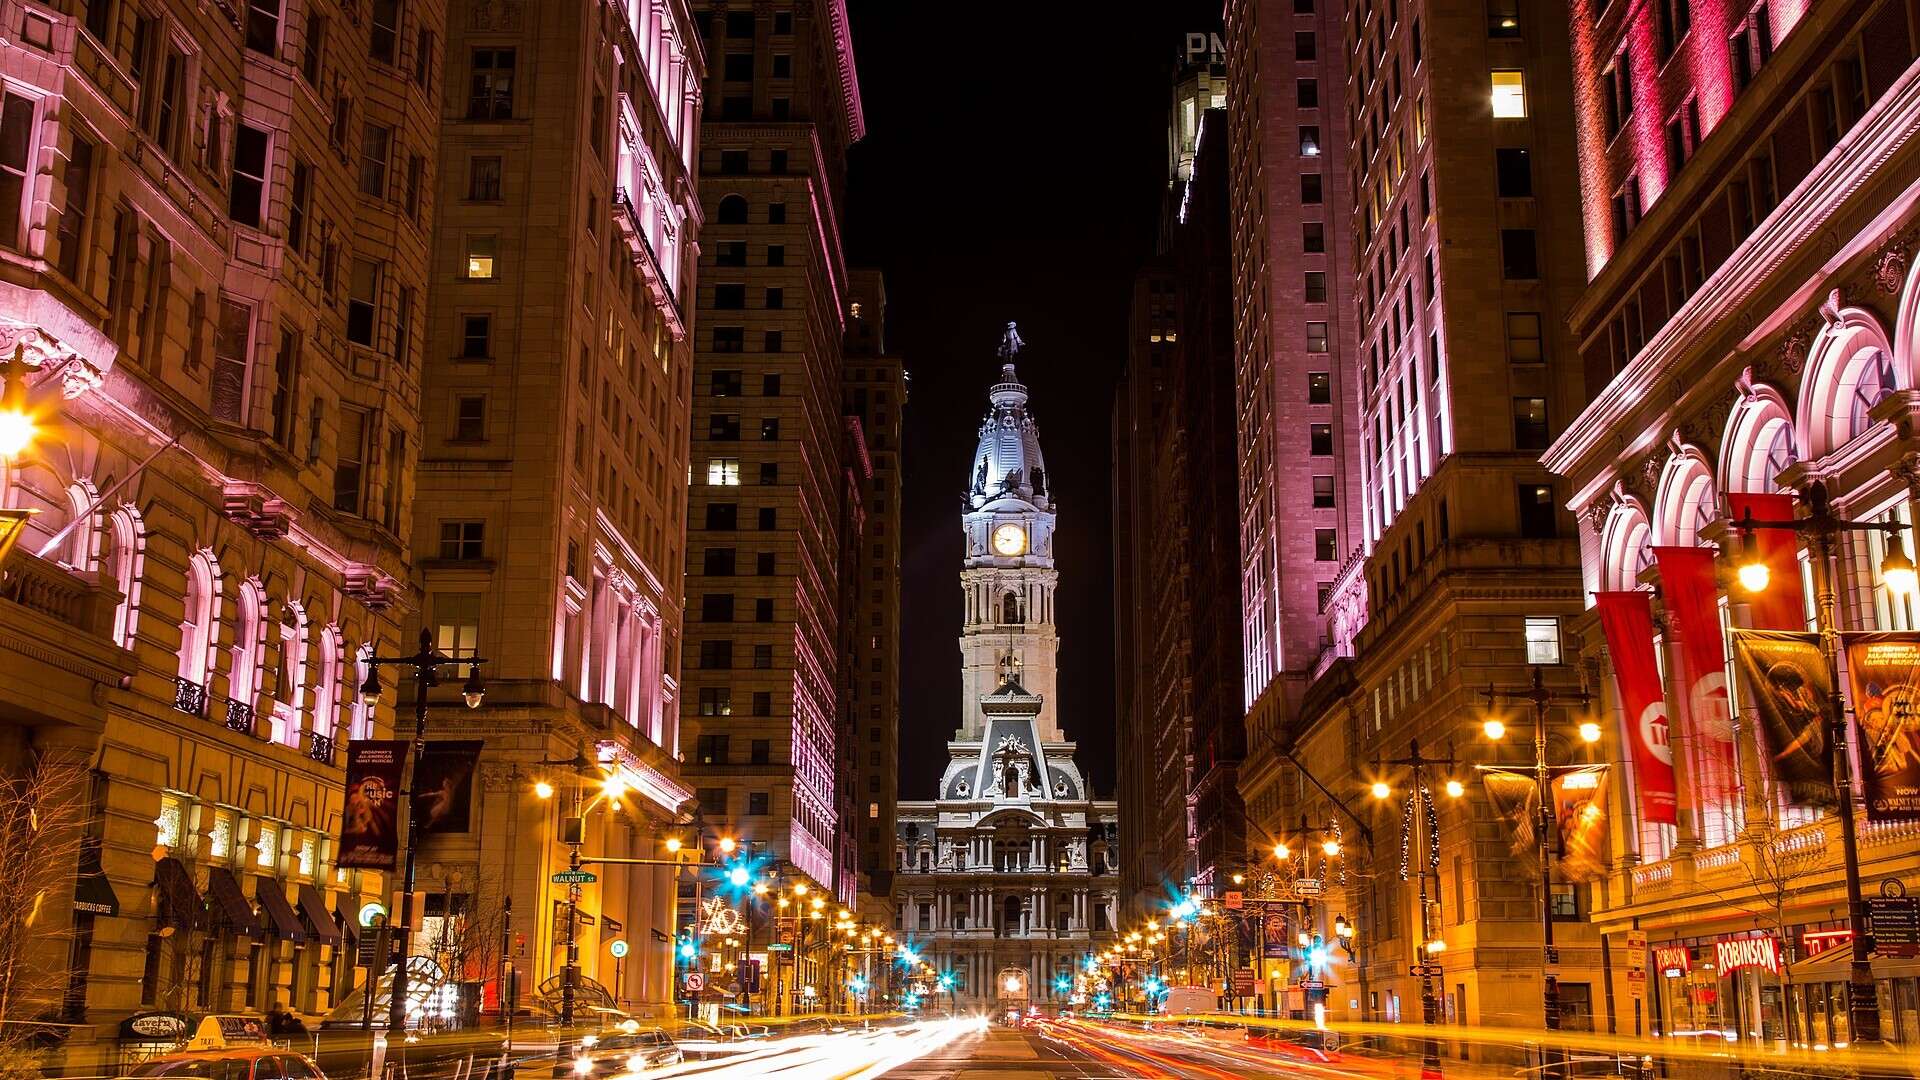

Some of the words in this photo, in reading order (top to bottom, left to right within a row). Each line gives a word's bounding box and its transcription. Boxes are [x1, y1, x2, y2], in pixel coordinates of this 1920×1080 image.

[1896, 788, 1918, 796] NOW
[554, 875, 586, 883] WALNUT
[73, 901, 95, 912] TARBUCKS
[95, 903, 112, 914] COFFEE
[1656, 947, 1688, 974] ROBINSON
[1717, 937, 1778, 977] ROBINSON
[200, 1038, 214, 1046] TAXI
